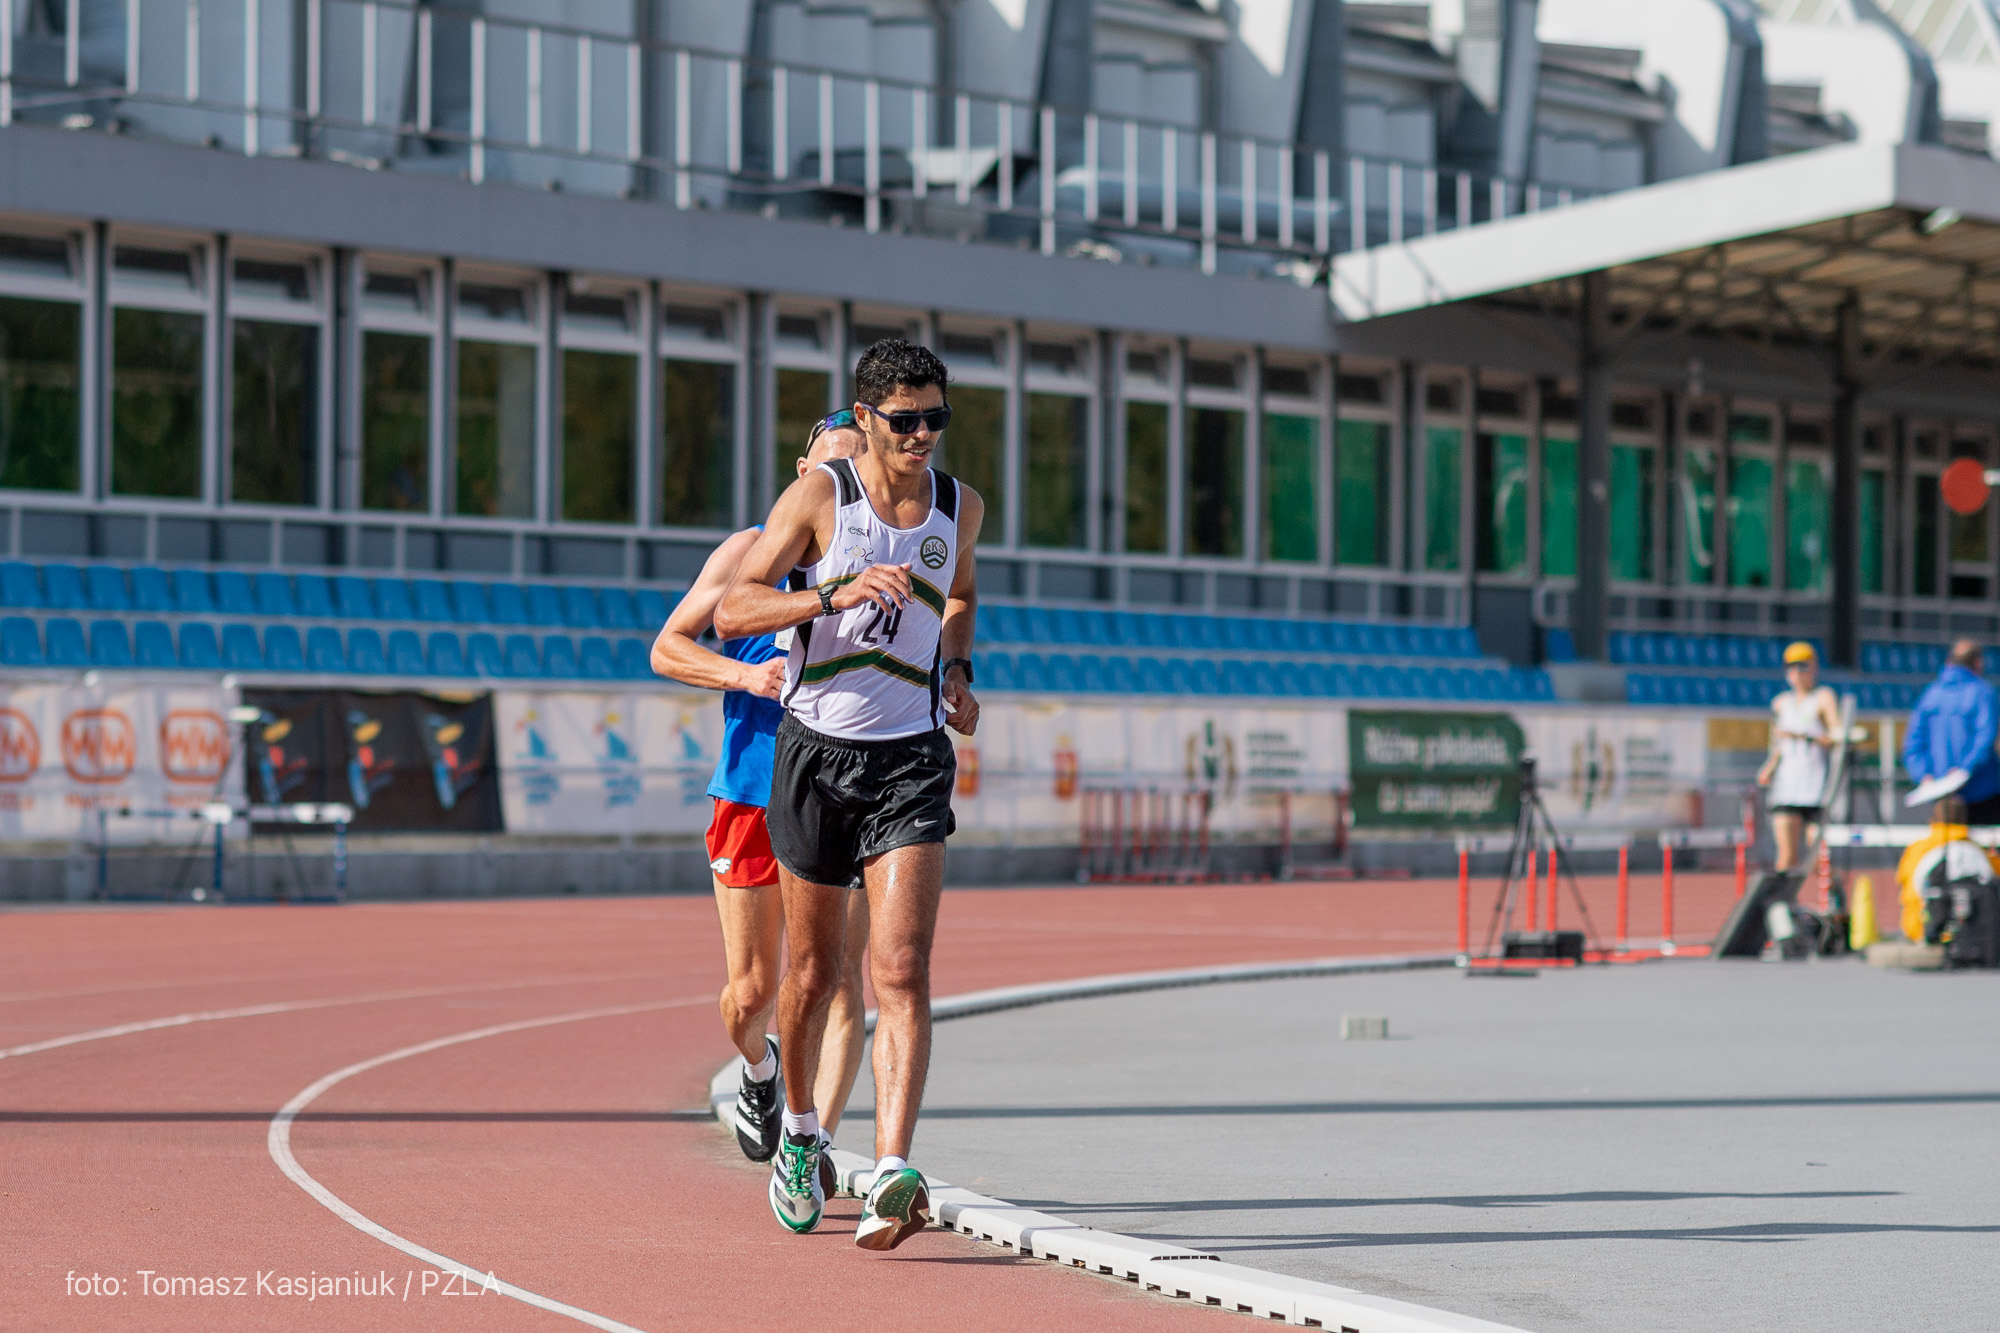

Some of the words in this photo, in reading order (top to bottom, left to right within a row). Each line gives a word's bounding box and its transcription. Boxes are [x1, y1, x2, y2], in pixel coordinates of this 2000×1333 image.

[924, 541, 945, 554] RKS
[861, 598, 905, 644] 24
[710, 857, 732, 874] 4F
